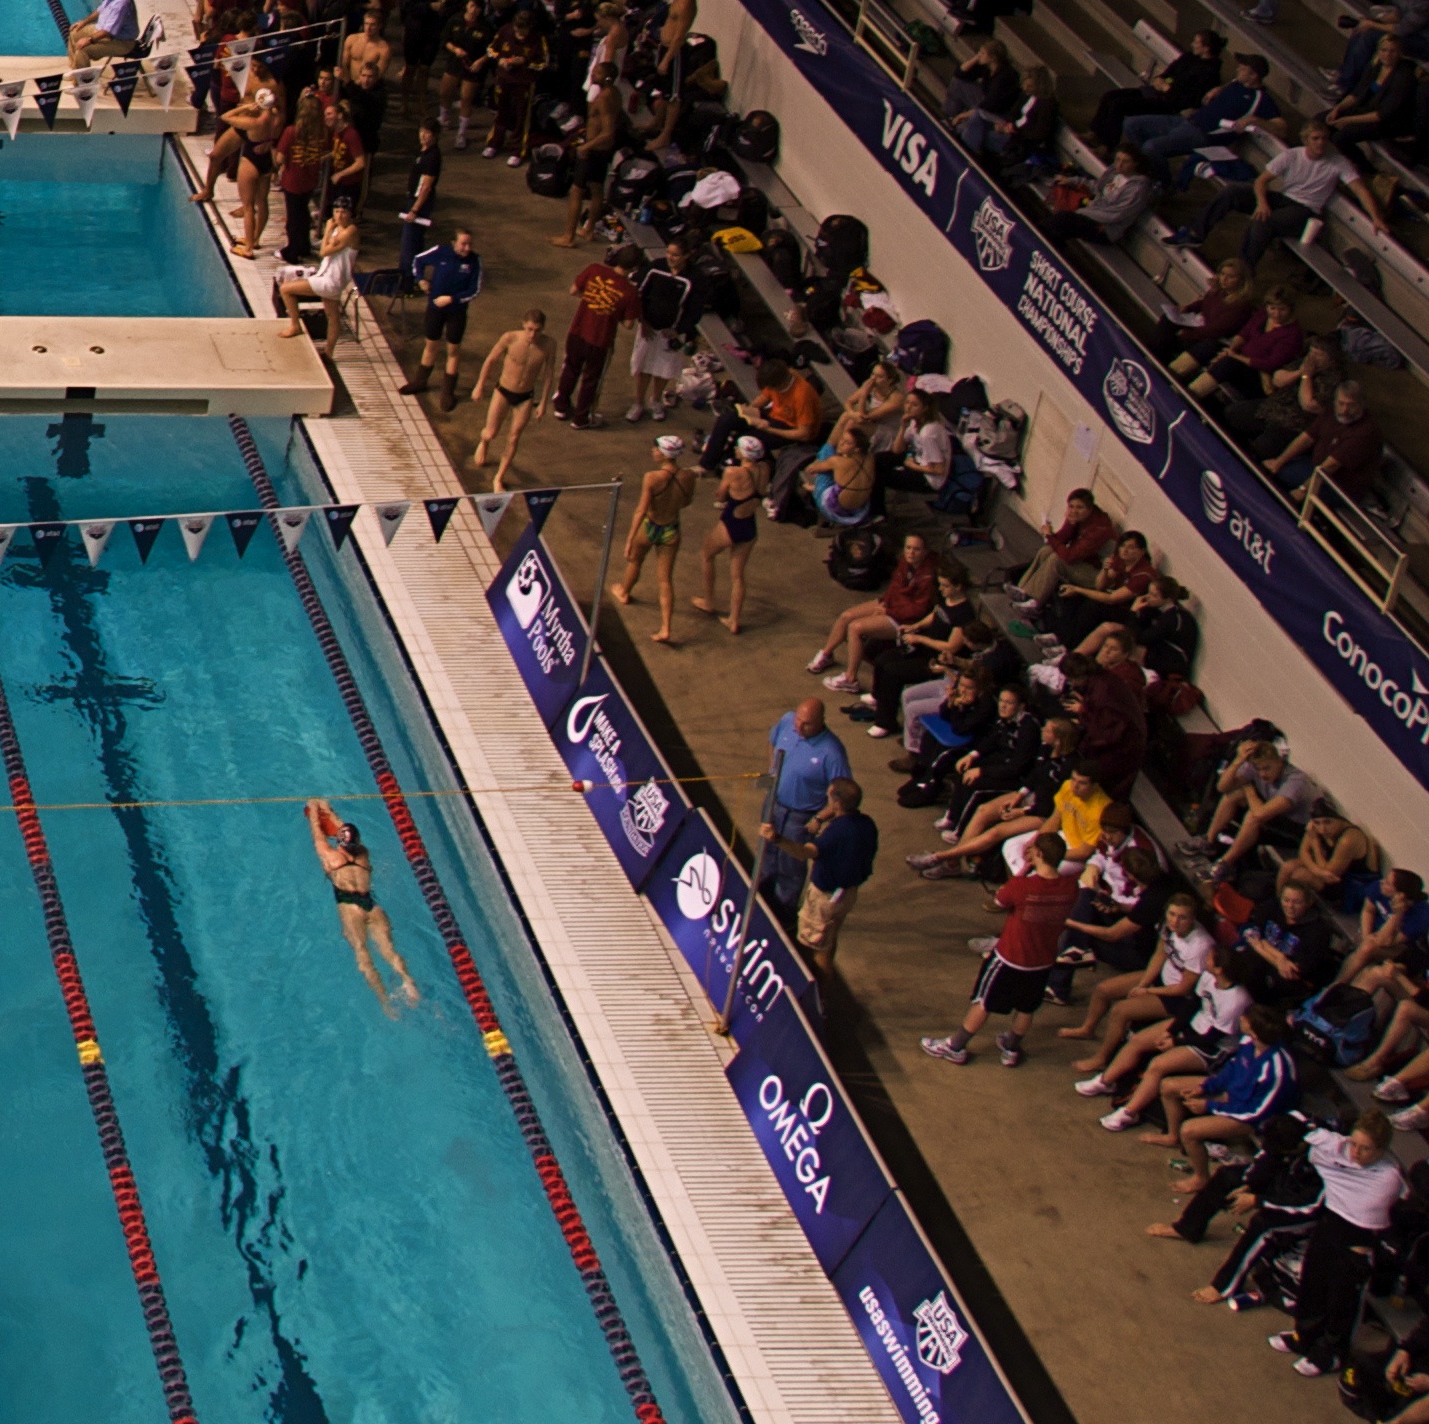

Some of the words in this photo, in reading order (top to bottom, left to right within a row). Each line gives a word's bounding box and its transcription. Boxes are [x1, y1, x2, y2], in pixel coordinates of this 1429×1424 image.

[791, 9, 828, 57] speedo
[881, 98, 939, 197] VISA
[1024, 273, 1088, 357] NATIONAL
[1030, 250, 1061, 289] SHORT
[1060, 281, 1097, 334] COURSE
[1017, 295, 1083, 375] CHAMPIONSHIPS
[1230, 510, 1276, 575] at&t
[527, 618, 555, 674] Pools
[542, 596, 575, 666] Myrtha
[594, 710, 618, 746] MAKE
[609, 739, 622, 756] A
[647, 785, 664, 812] USA
[703, 928, 765, 1023] netwok.com
[759, 1075, 831, 1215] OMEGA
[933, 1305, 958, 1347] USA
